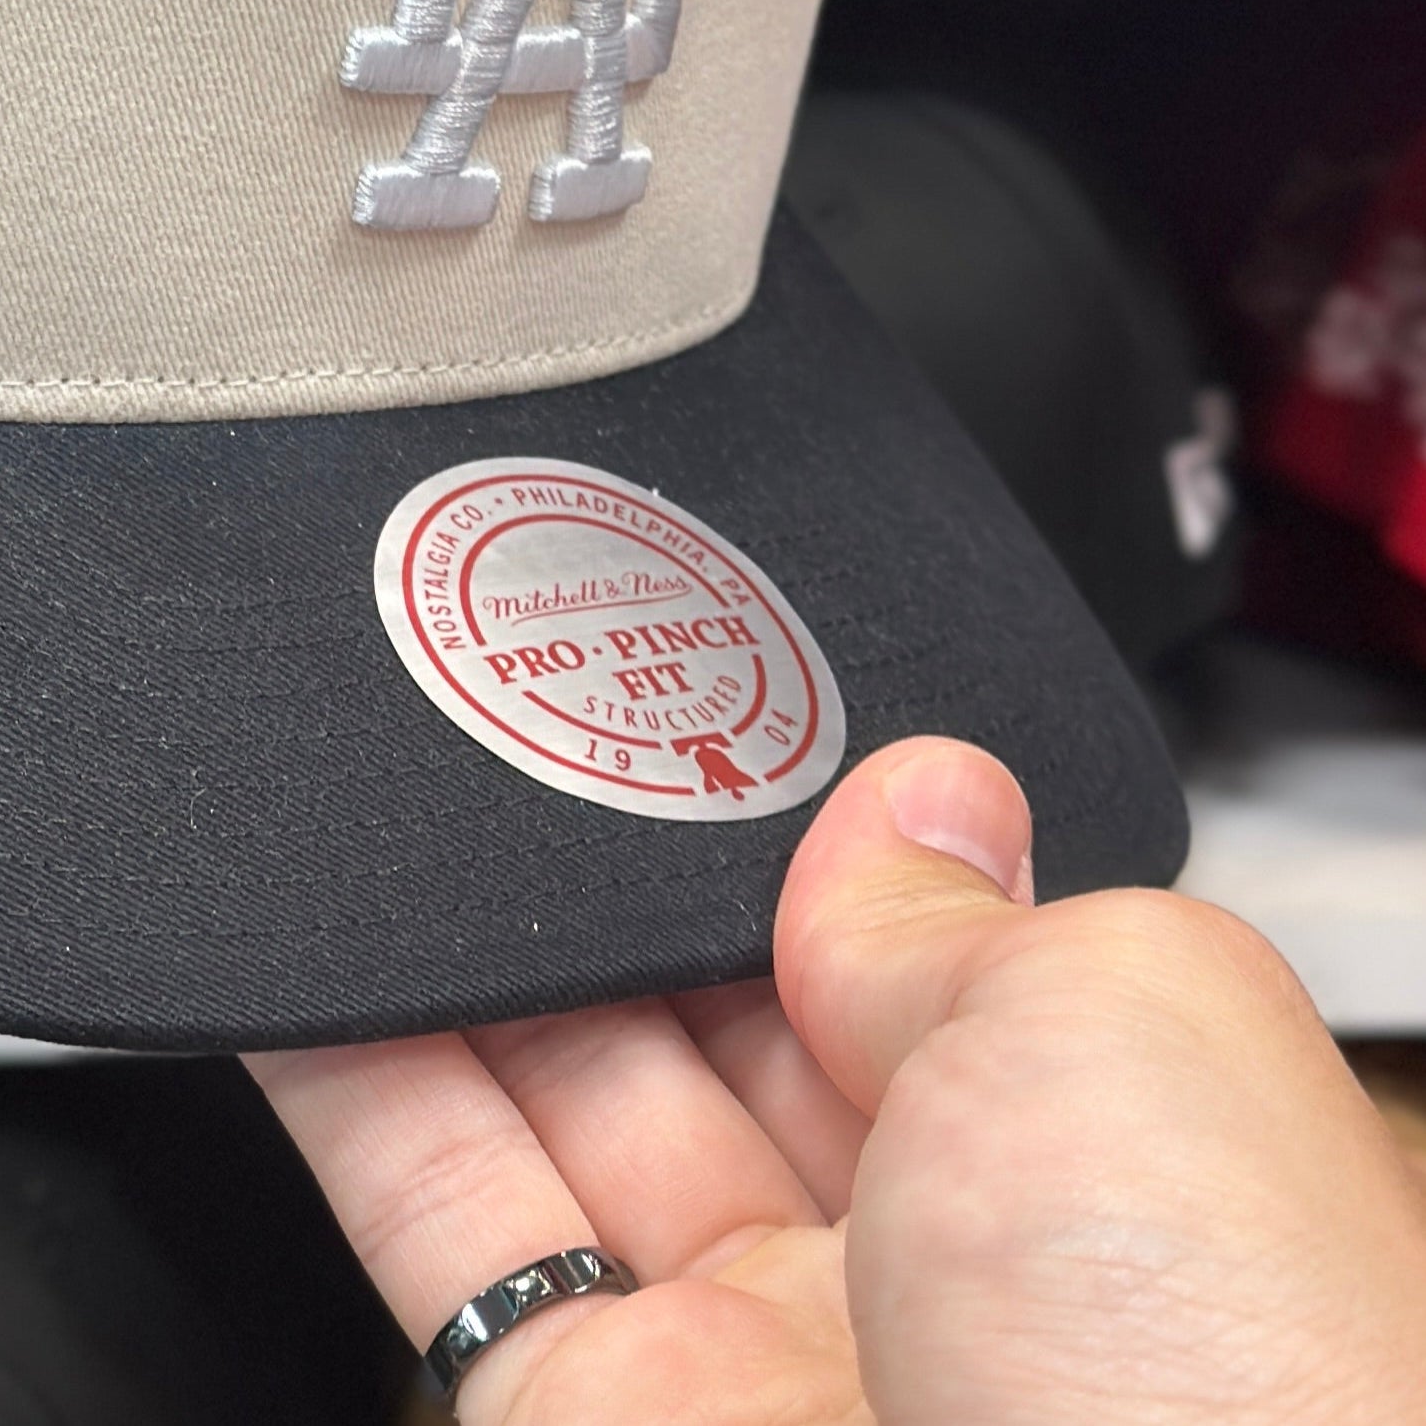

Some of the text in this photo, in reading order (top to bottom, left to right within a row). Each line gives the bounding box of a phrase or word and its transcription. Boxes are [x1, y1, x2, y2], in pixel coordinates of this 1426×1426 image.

[422, 531, 467, 650] NOSTALGIA
[451, 502, 493, 531] CO.
[721, 577, 752, 607] PA
[482, 572, 693, 621] Mitchell & Ness
[583, 672, 742, 731] STRUCTURED
[612, 661, 694, 701] FIT
